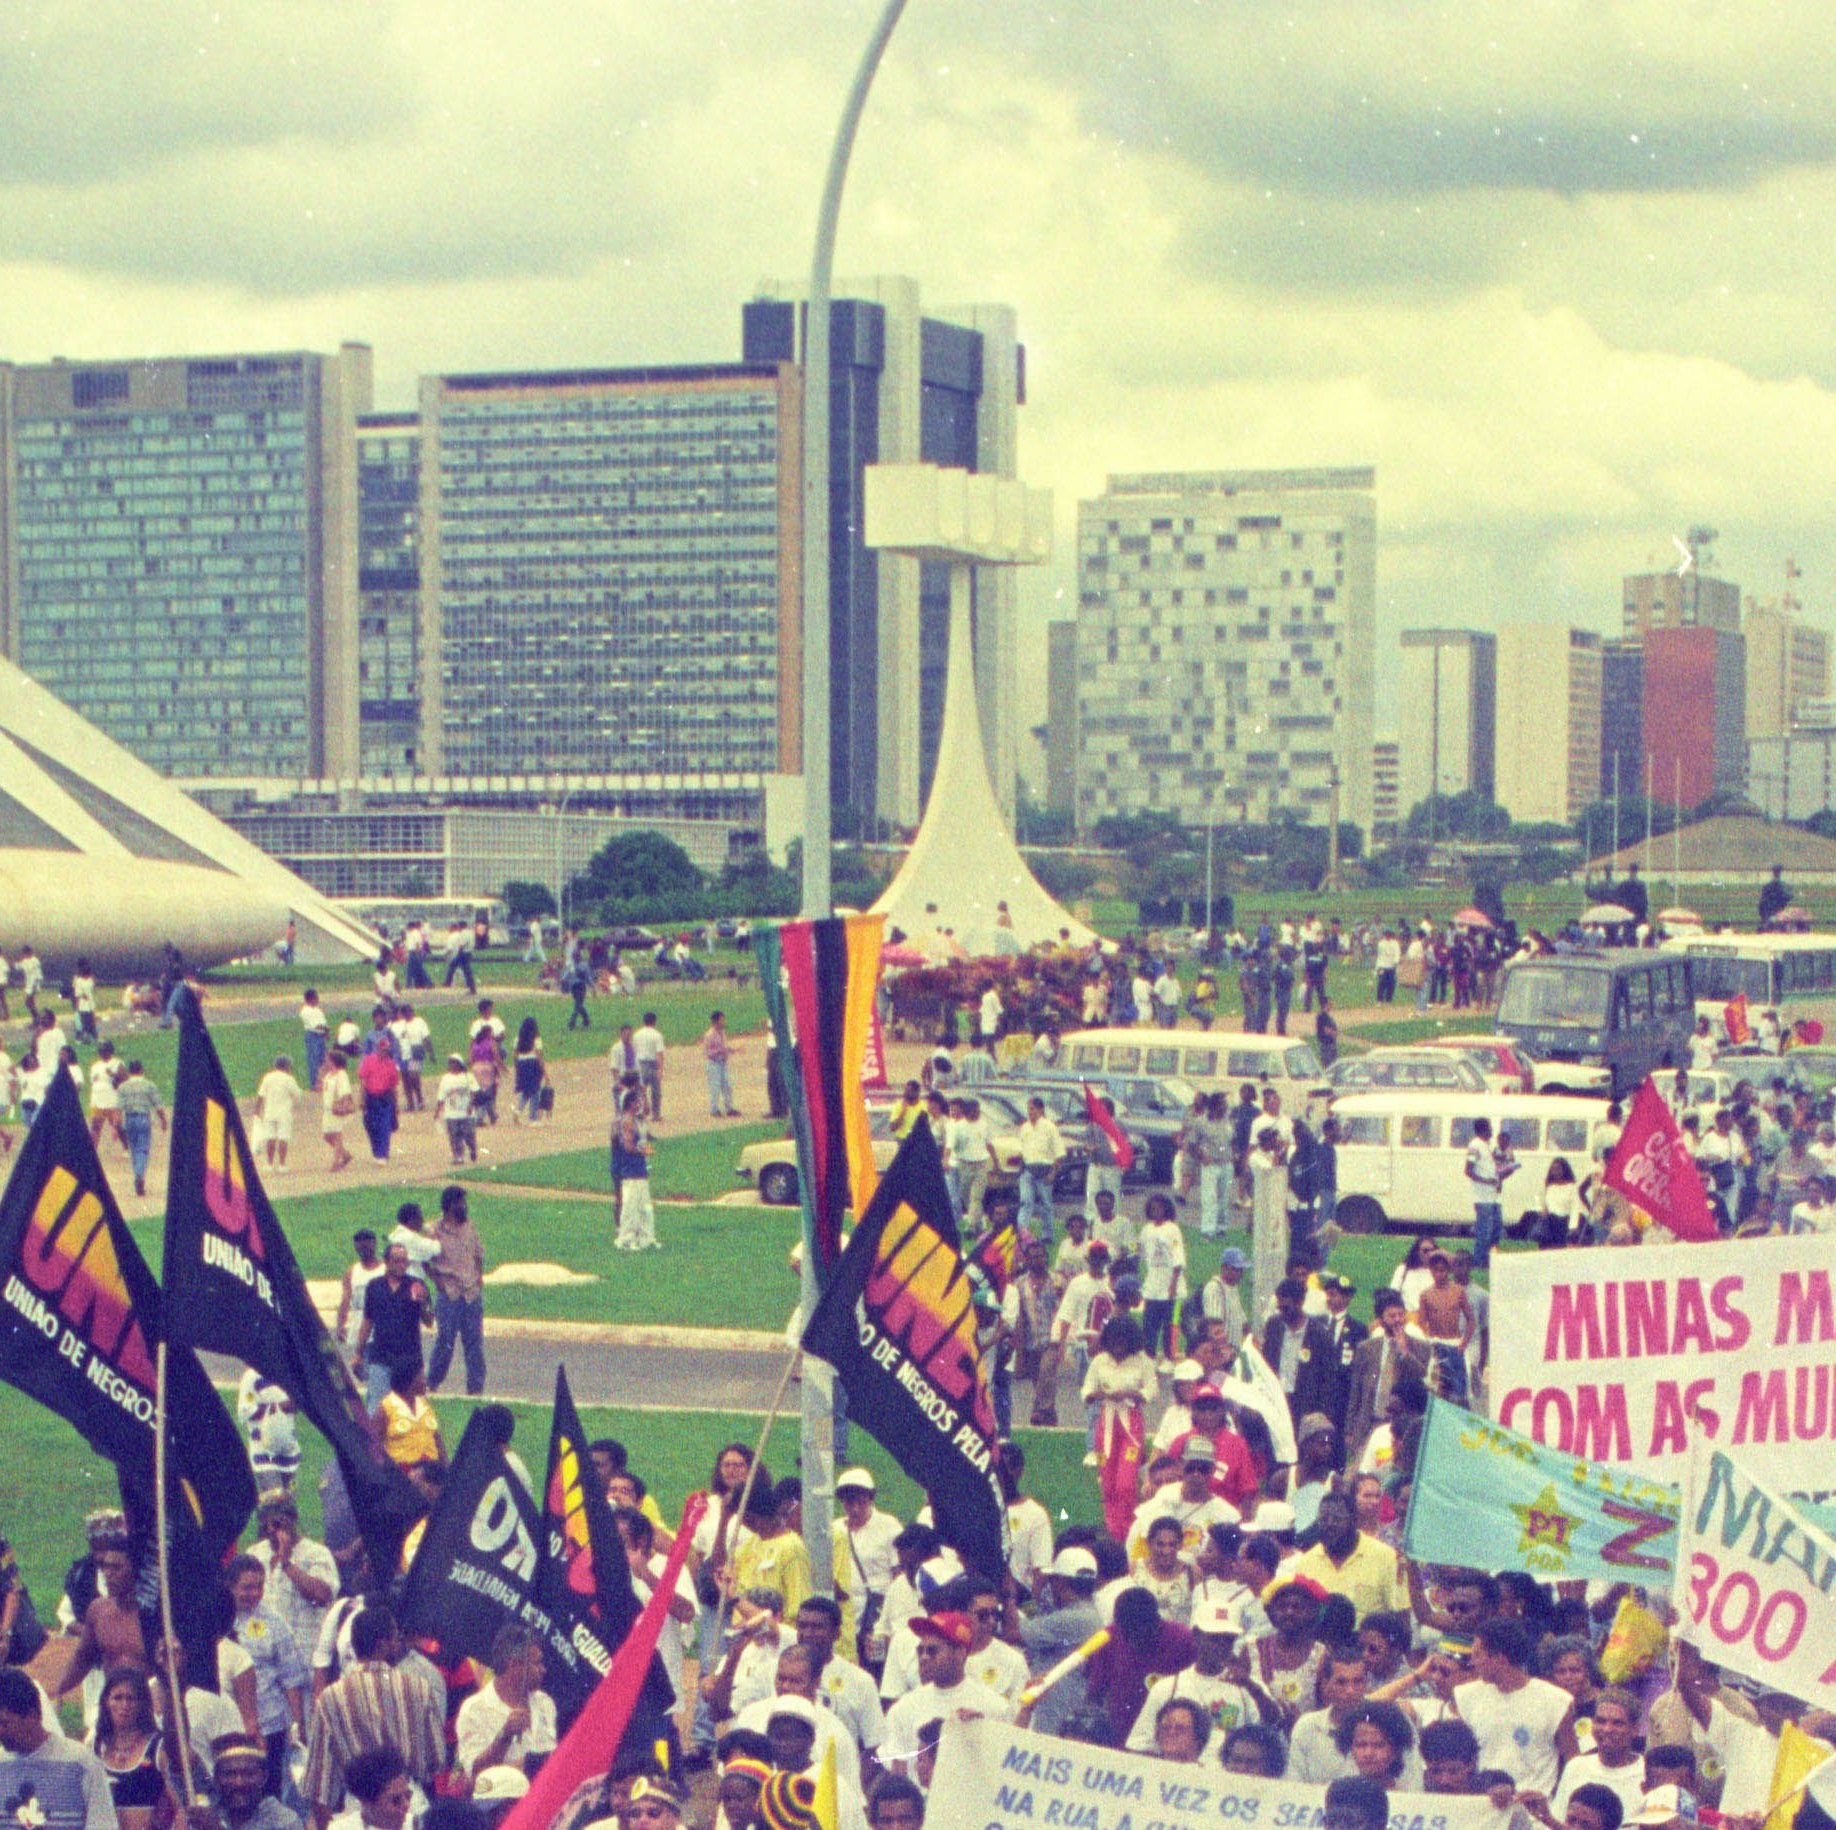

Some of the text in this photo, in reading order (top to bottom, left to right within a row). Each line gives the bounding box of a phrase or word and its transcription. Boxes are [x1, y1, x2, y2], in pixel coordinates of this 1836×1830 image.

[59, 1330, 86, 1368] DE
[1544, 1275, 1751, 1361] MINAS
[871, 1337, 991, 1474] DE NEGROS PELA
[1499, 1384, 1632, 1461] COM
[1649, 1378, 1721, 1456] AS
[1528, 1509, 1569, 1544] PT
[1687, 1552, 1807, 1662] 300
[996, 1785, 1034, 1818] NA
[1002, 1745, 1073, 1785] MAIS
[1083, 1766, 1144, 1800] UMA
[1160, 1781, 1210, 1813] VEZ
[1219, 1795, 1260, 1823] OS
